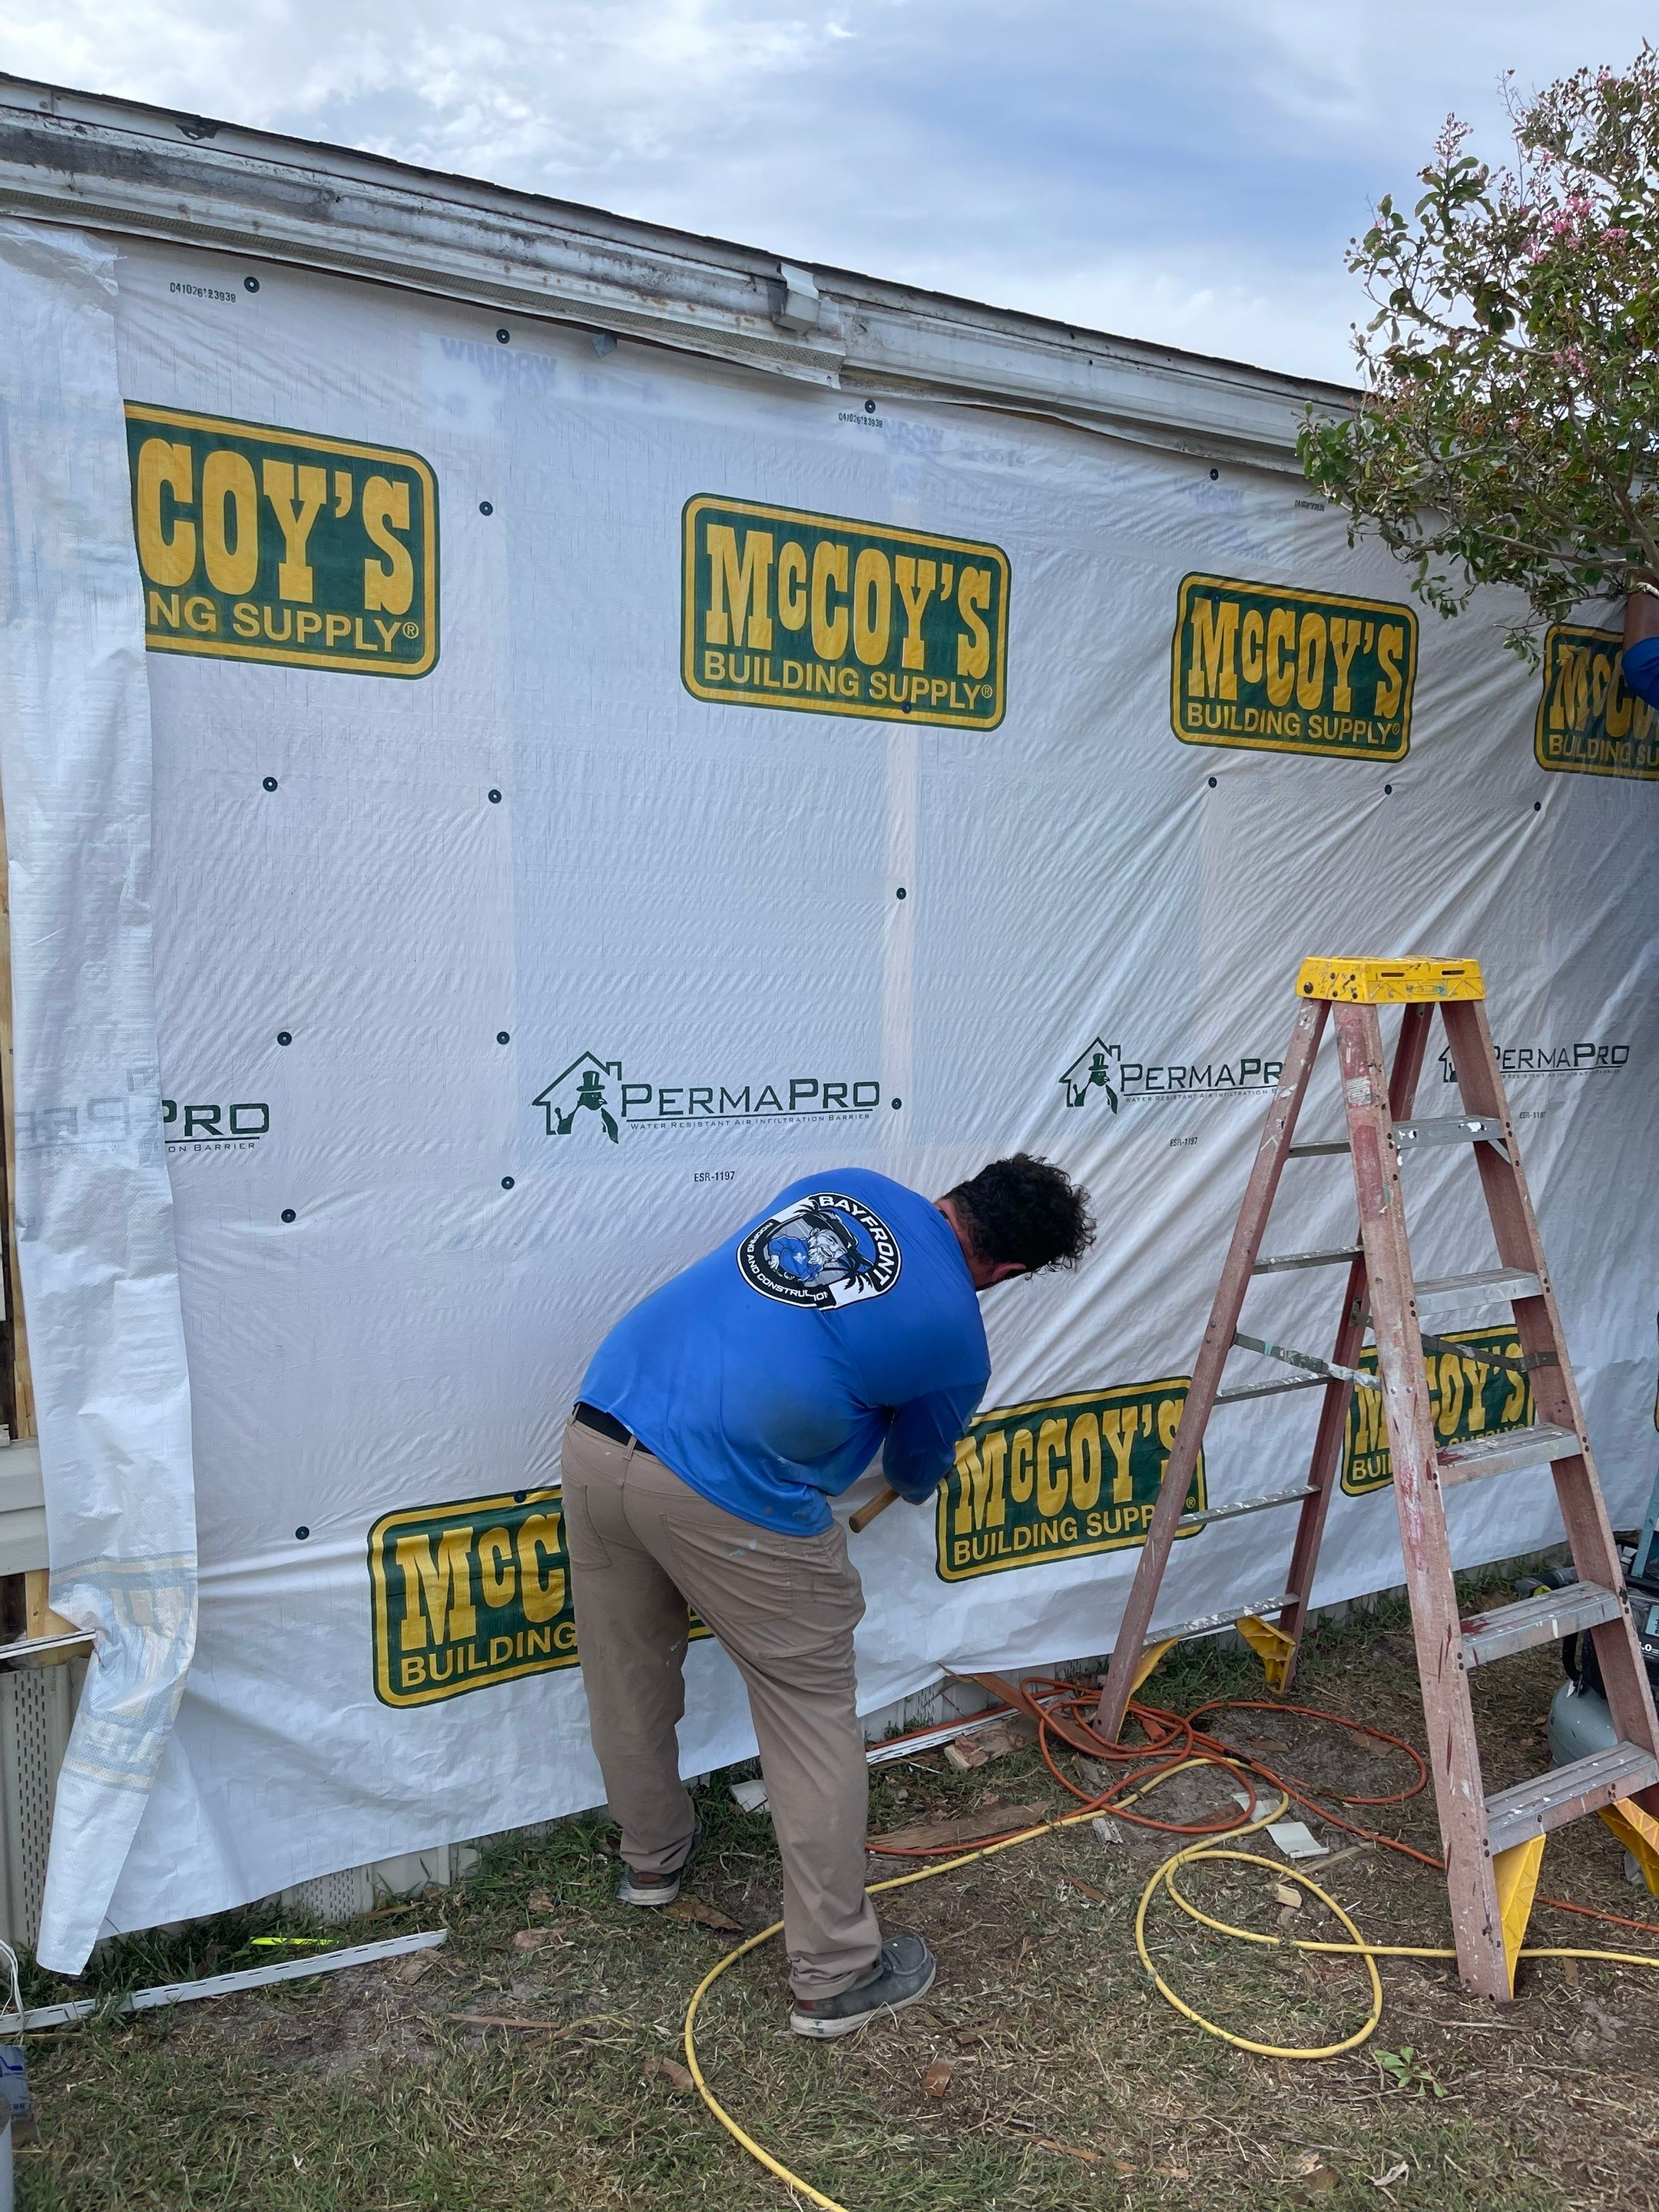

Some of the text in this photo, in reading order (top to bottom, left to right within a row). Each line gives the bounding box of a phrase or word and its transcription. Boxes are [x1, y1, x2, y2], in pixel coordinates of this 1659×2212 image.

[704, 651, 859, 698] BUILDING
[1187, 702, 1301, 737] BUILDING
[671, 1120, 730, 1129] RESISTANT
[828, 1114, 870, 1122] BARRIER
[194, 1142, 256, 1151] BARRIER
[1169, 1137, 1198, 1147] ESR-1197
[694, 1171, 736, 1183] ESR-1197
[747, 1254, 760, 1274] AND
[954, 1516, 1078, 1566] BUILDING
[401, 1621, 578, 1688] BUILDING
